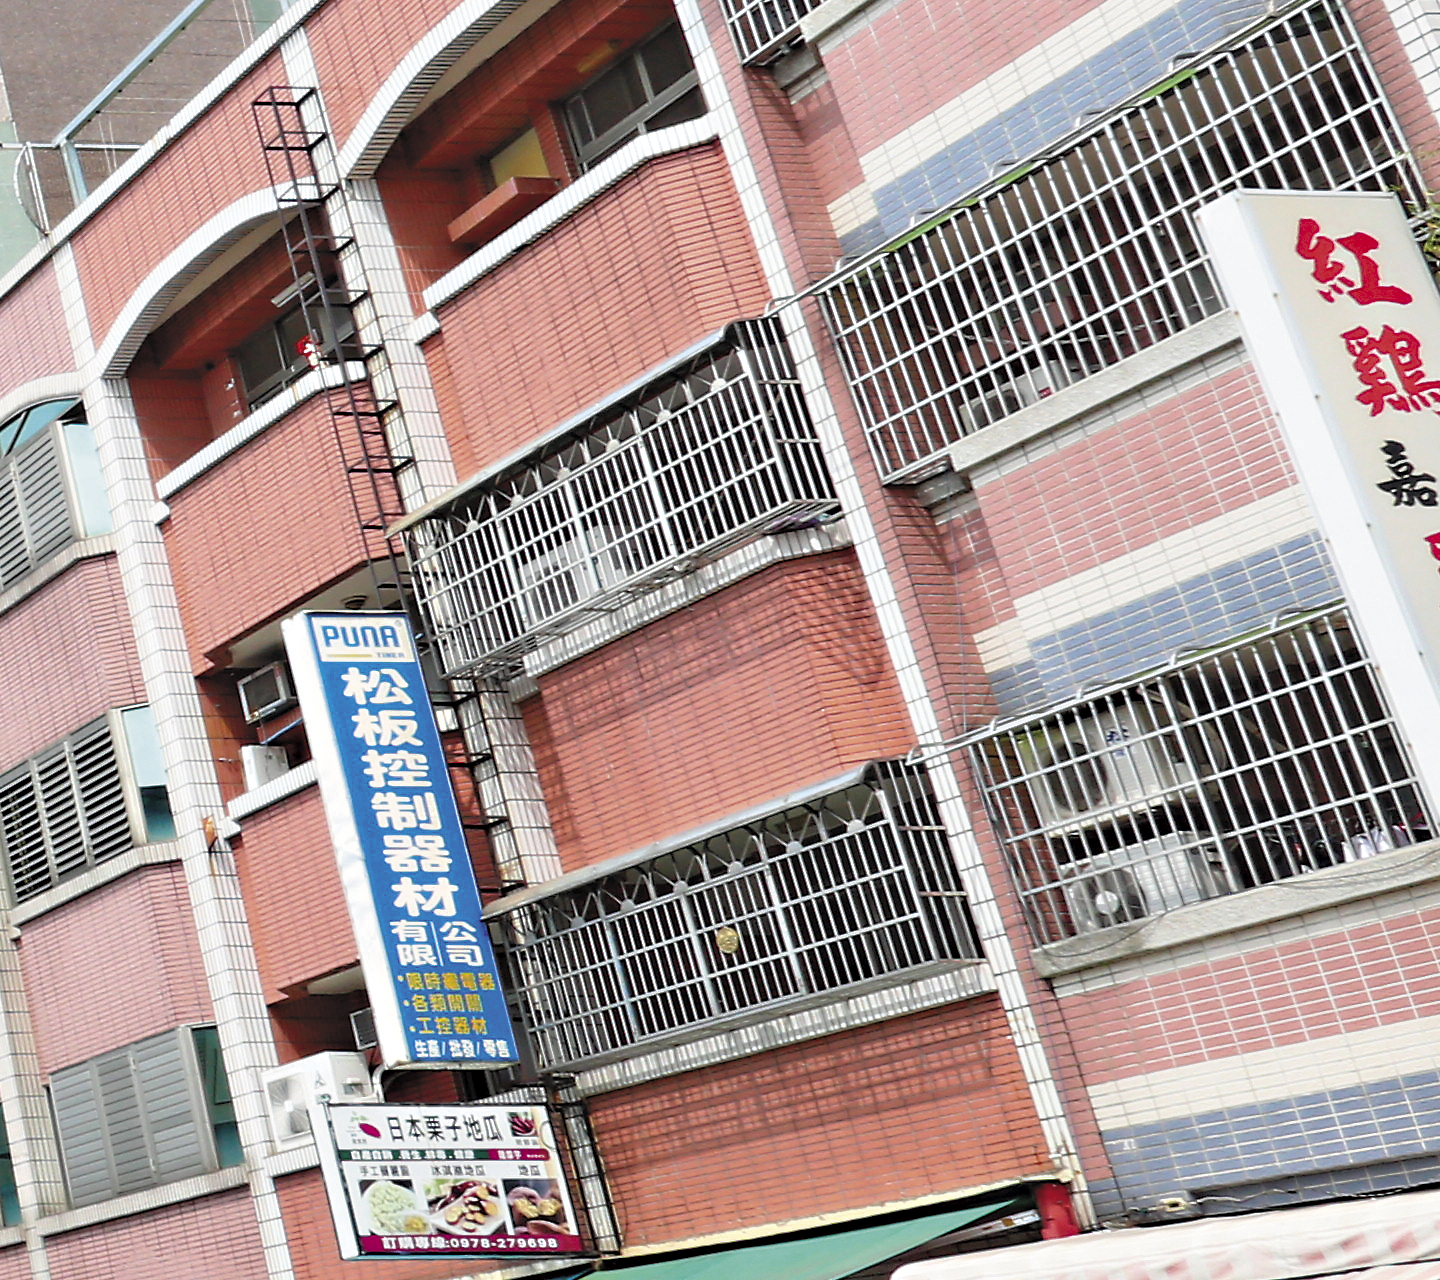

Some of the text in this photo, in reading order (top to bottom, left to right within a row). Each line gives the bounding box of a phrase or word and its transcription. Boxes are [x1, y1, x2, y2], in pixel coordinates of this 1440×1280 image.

[321, 625, 400, 648] PUNA
[341, 666, 460, 917] 松板控制器材
[387, 1113, 503, 1142] 日本栗子地瓜
